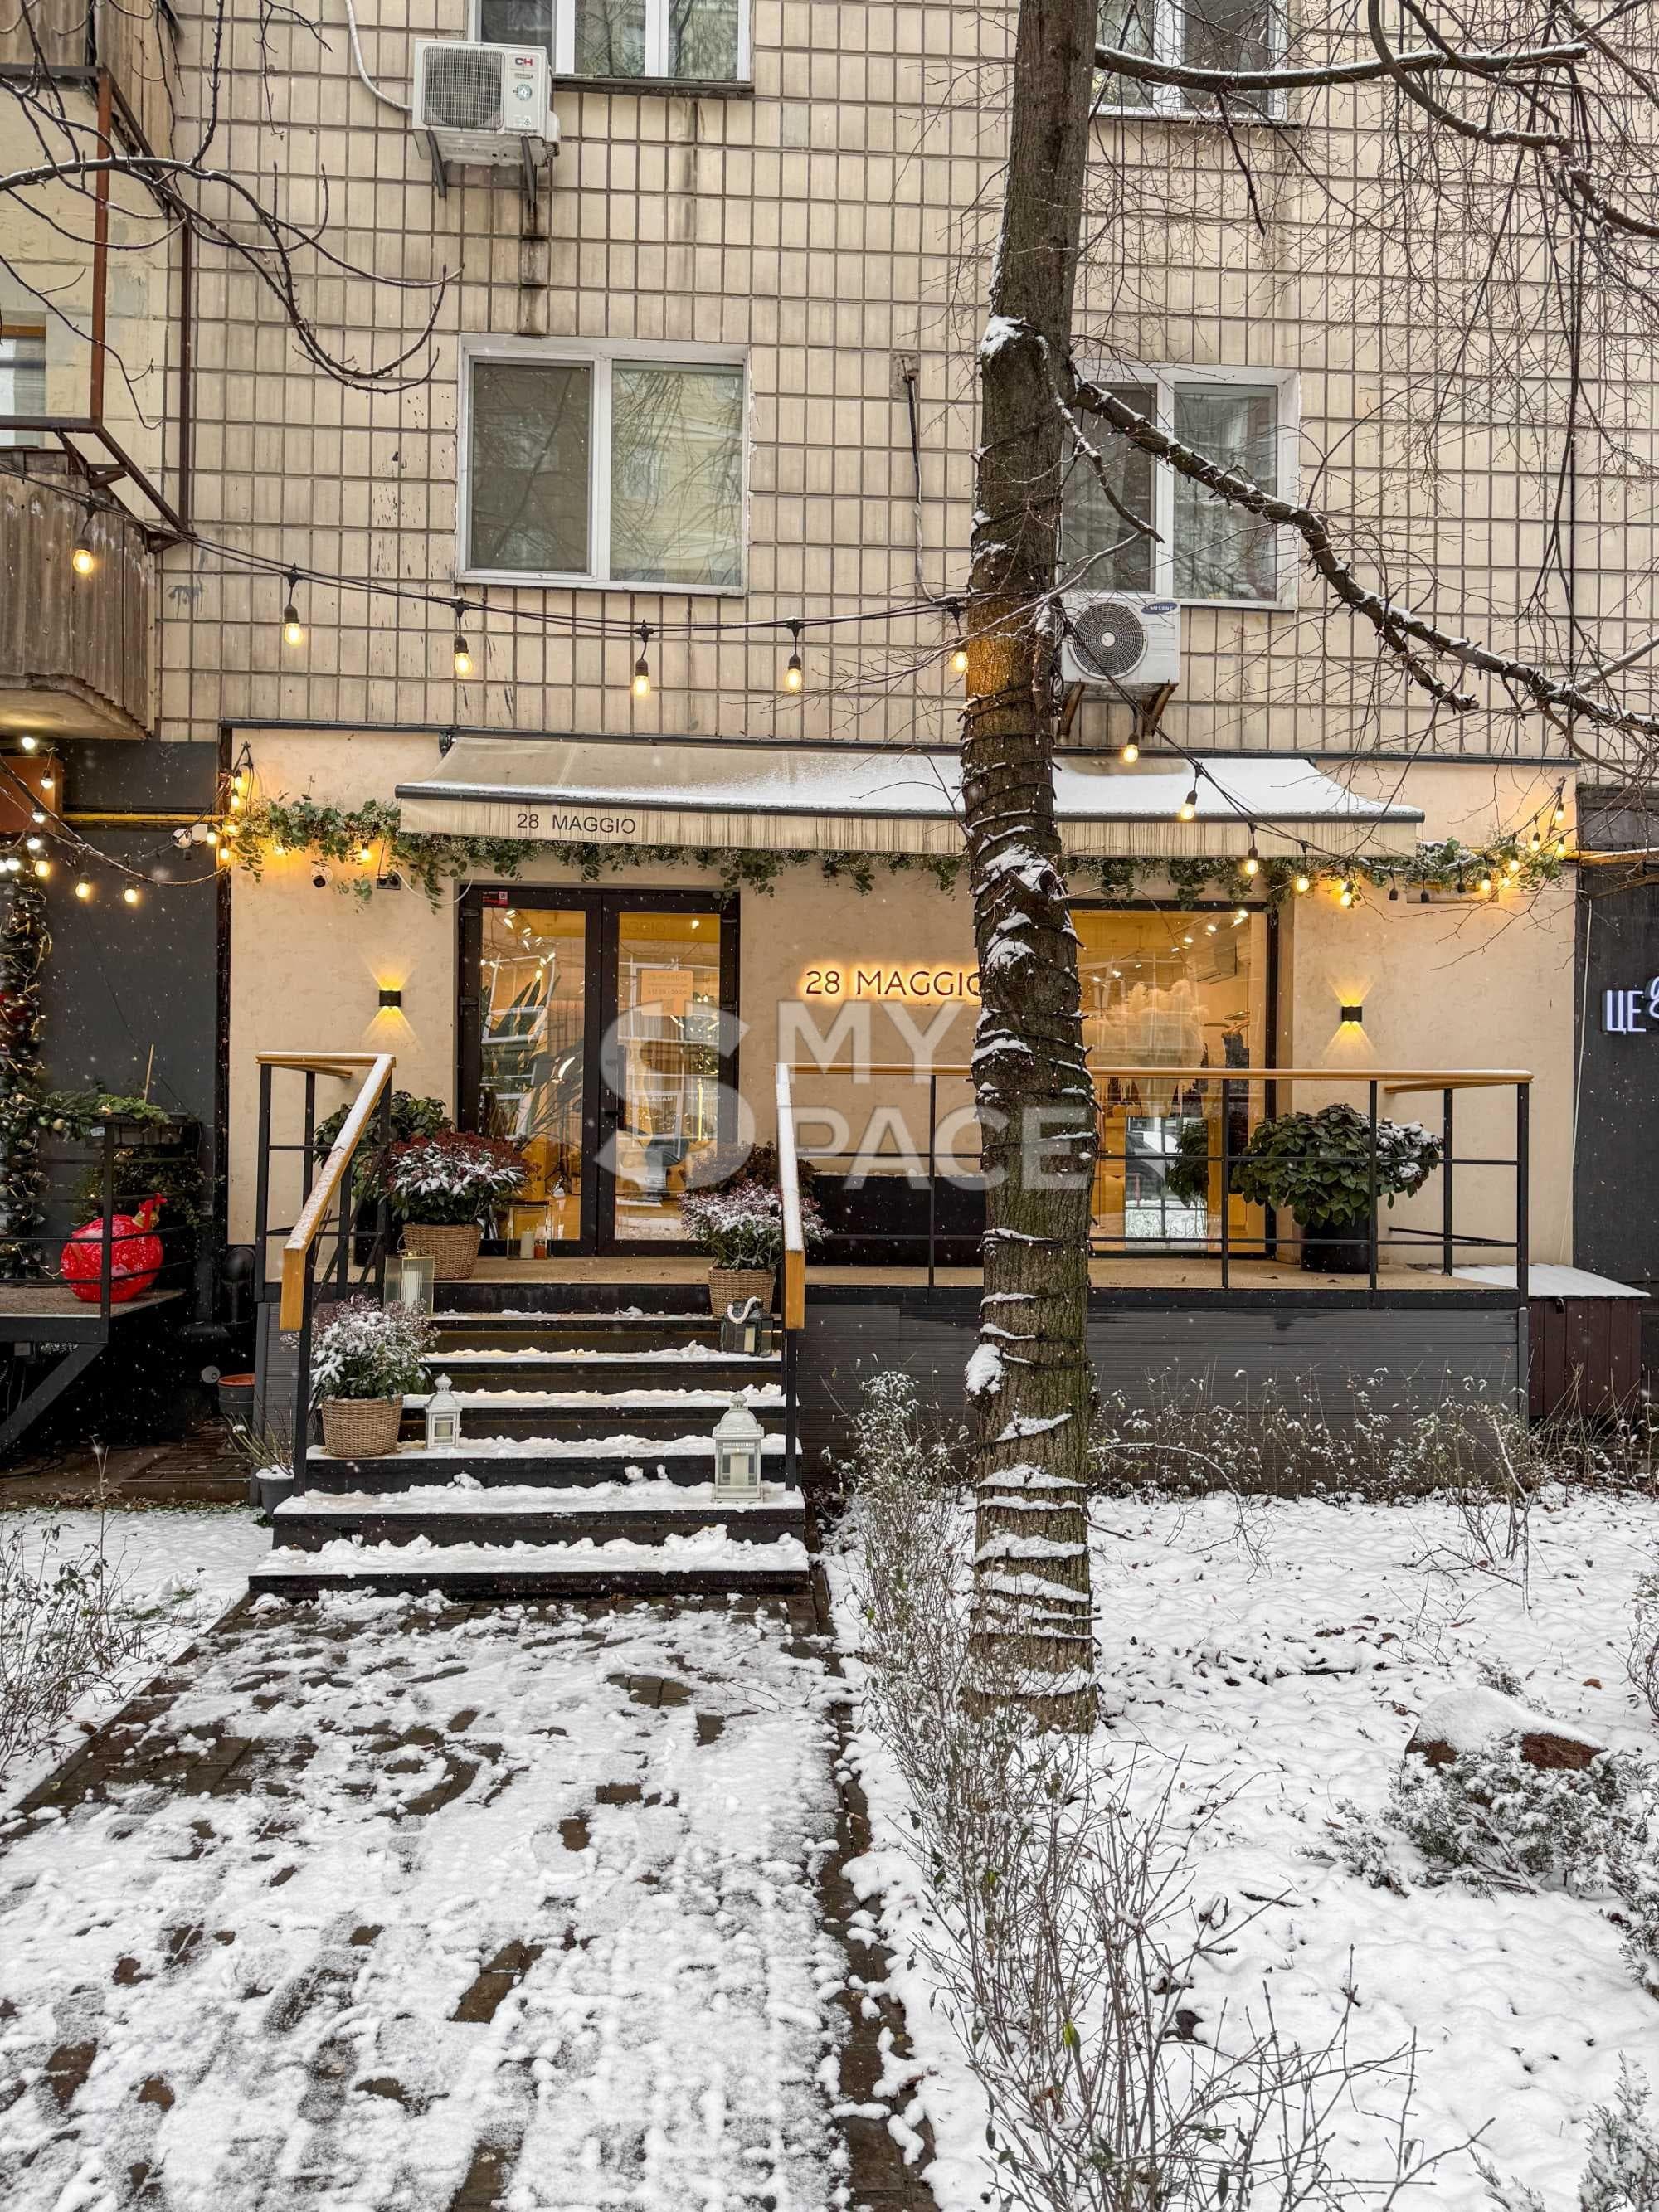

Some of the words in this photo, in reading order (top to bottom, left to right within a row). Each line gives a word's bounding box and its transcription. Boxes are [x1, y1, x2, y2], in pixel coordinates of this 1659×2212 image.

[514, 57, 533, 66] CH
[517, 813, 539, 829] 28
[552, 814, 636, 834] MAGGIO
[805, 970, 840, 994] 28
